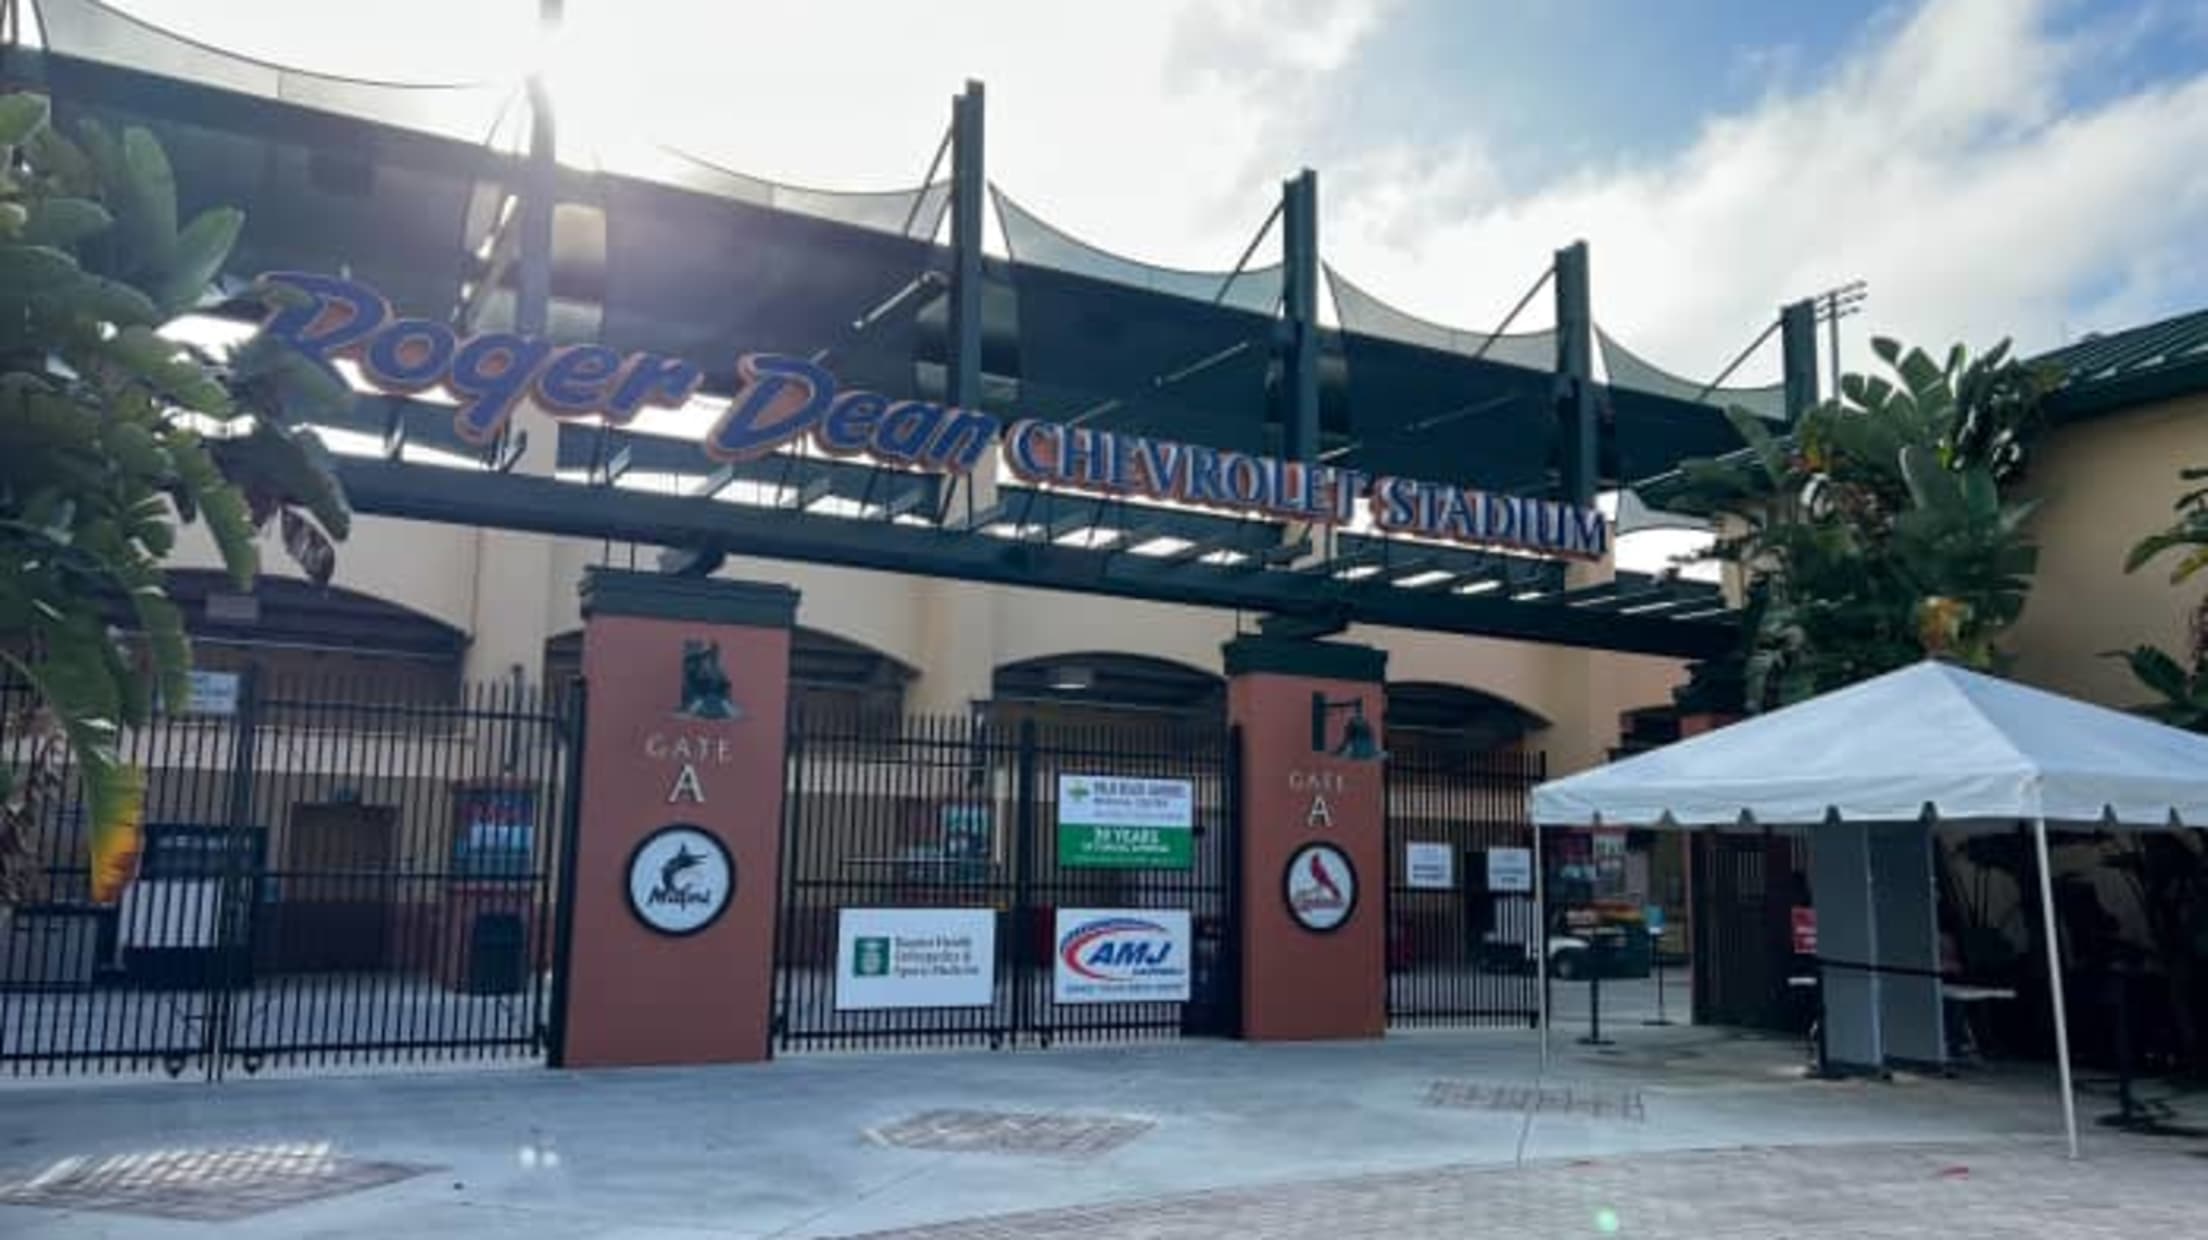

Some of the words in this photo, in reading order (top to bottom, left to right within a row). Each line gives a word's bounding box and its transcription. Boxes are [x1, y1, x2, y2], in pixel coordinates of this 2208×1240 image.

[254, 271, 702, 447] Roger
[705, 352, 1000, 476] Dean
[1002, 418, 1368, 528] CHEVROLET
[1370, 474, 1607, 562] STADIUM
[645, 734, 732, 764] GATE
[668, 764, 704, 803] A
[1308, 795, 1334, 828] A
[1088, 941, 1172, 966] AMJ
